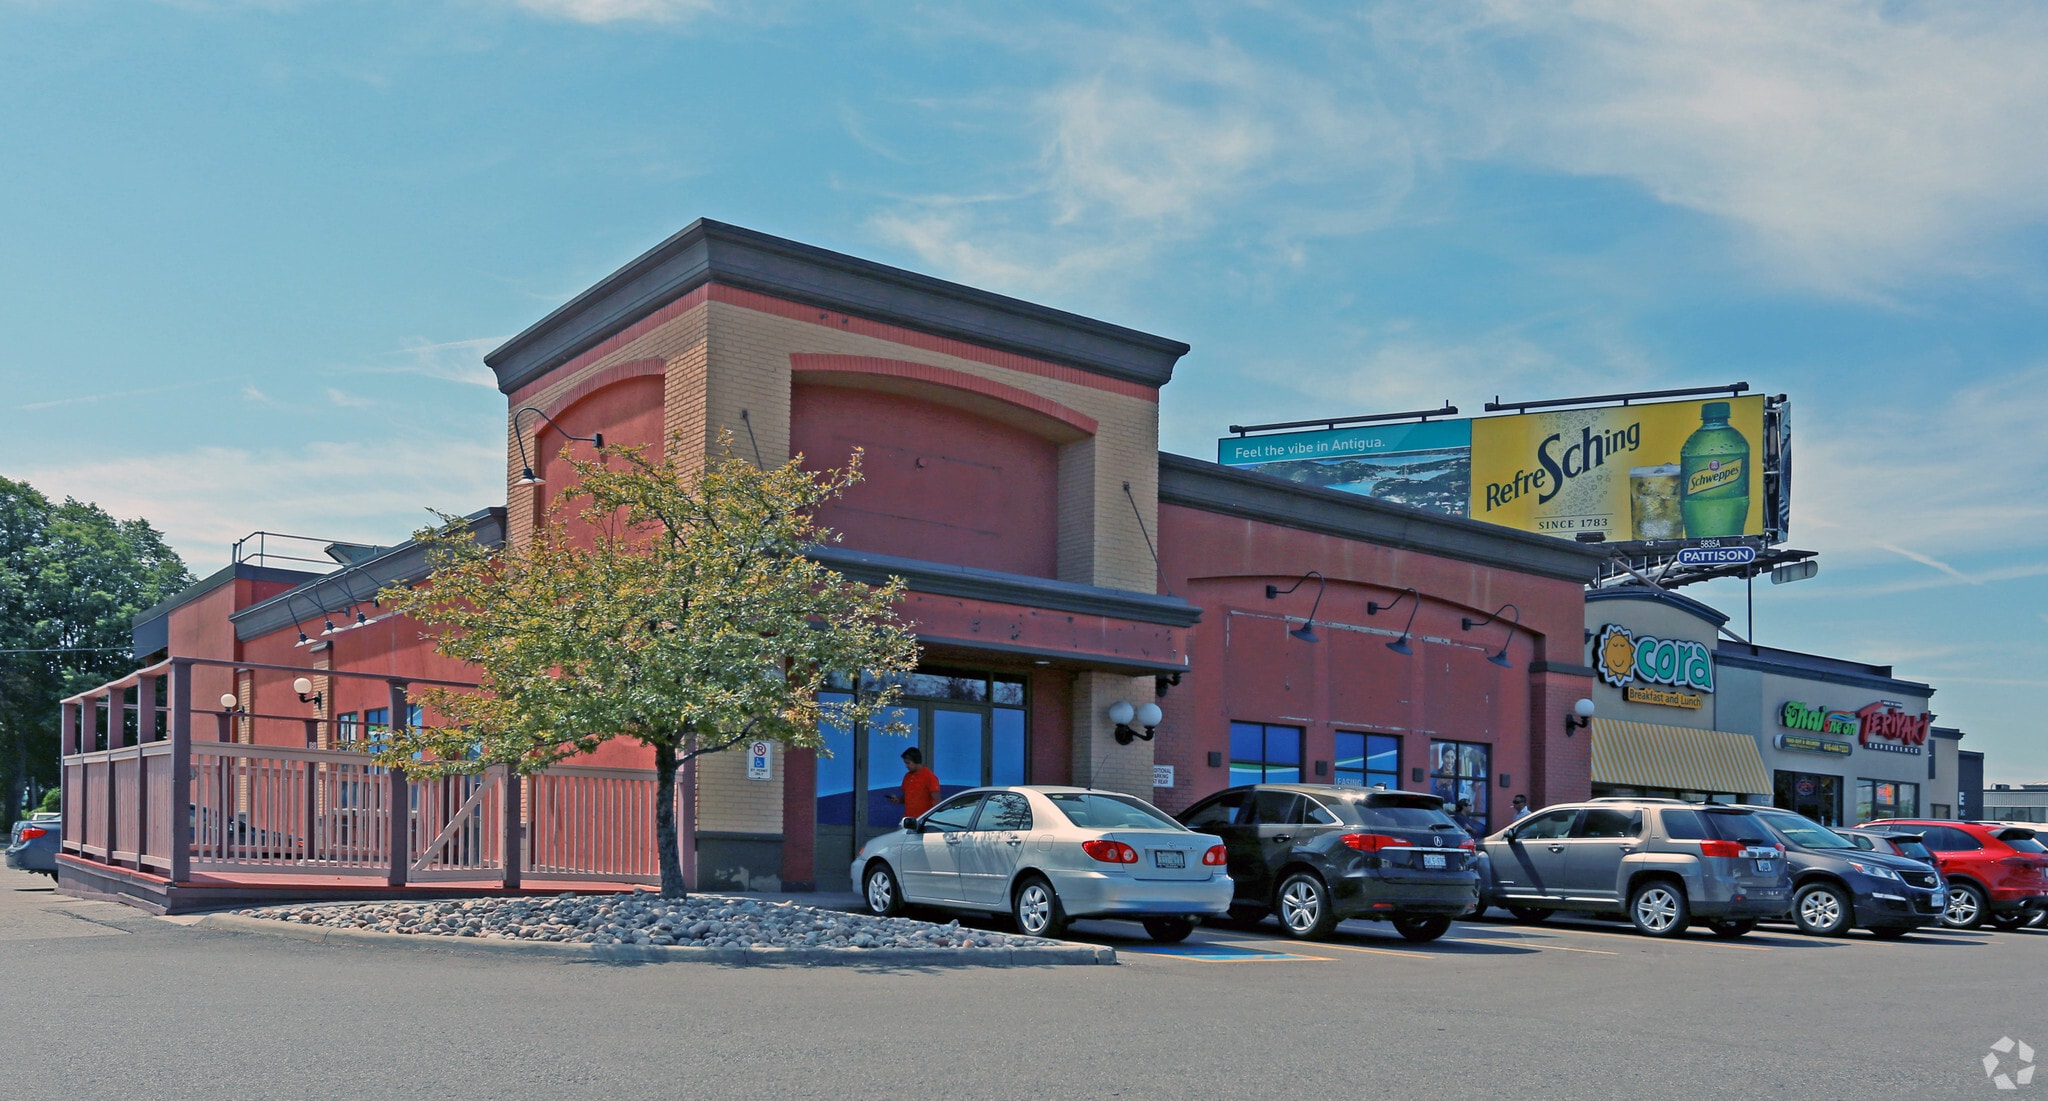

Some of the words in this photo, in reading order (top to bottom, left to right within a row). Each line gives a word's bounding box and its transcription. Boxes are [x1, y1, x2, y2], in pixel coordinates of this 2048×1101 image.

[1235, 446, 1261, 459] Feel
[1265, 445, 1285, 456] the
[1288, 443, 1314, 454] vibe
[1317, 441, 1329, 452] in
[1332, 438, 1386, 451] Antigua.
[1486, 422, 1640, 512] RefreSching
[1690, 466, 1740, 491] Schweppes
[1539, 519, 1575, 530] SINCE
[1581, 518, 1609, 528] 1783
[1683, 550, 1750, 562] PATTISON
[1636, 638, 1712, 688] cora
[1630, 688, 1664, 702] Breakfast
[1665, 692, 1679, 704] and
[1681, 695, 1702, 707] Lunch
[1784, 701, 1827, 731] Thai
[1869, 743, 1919, 755] EXPERIENCE
